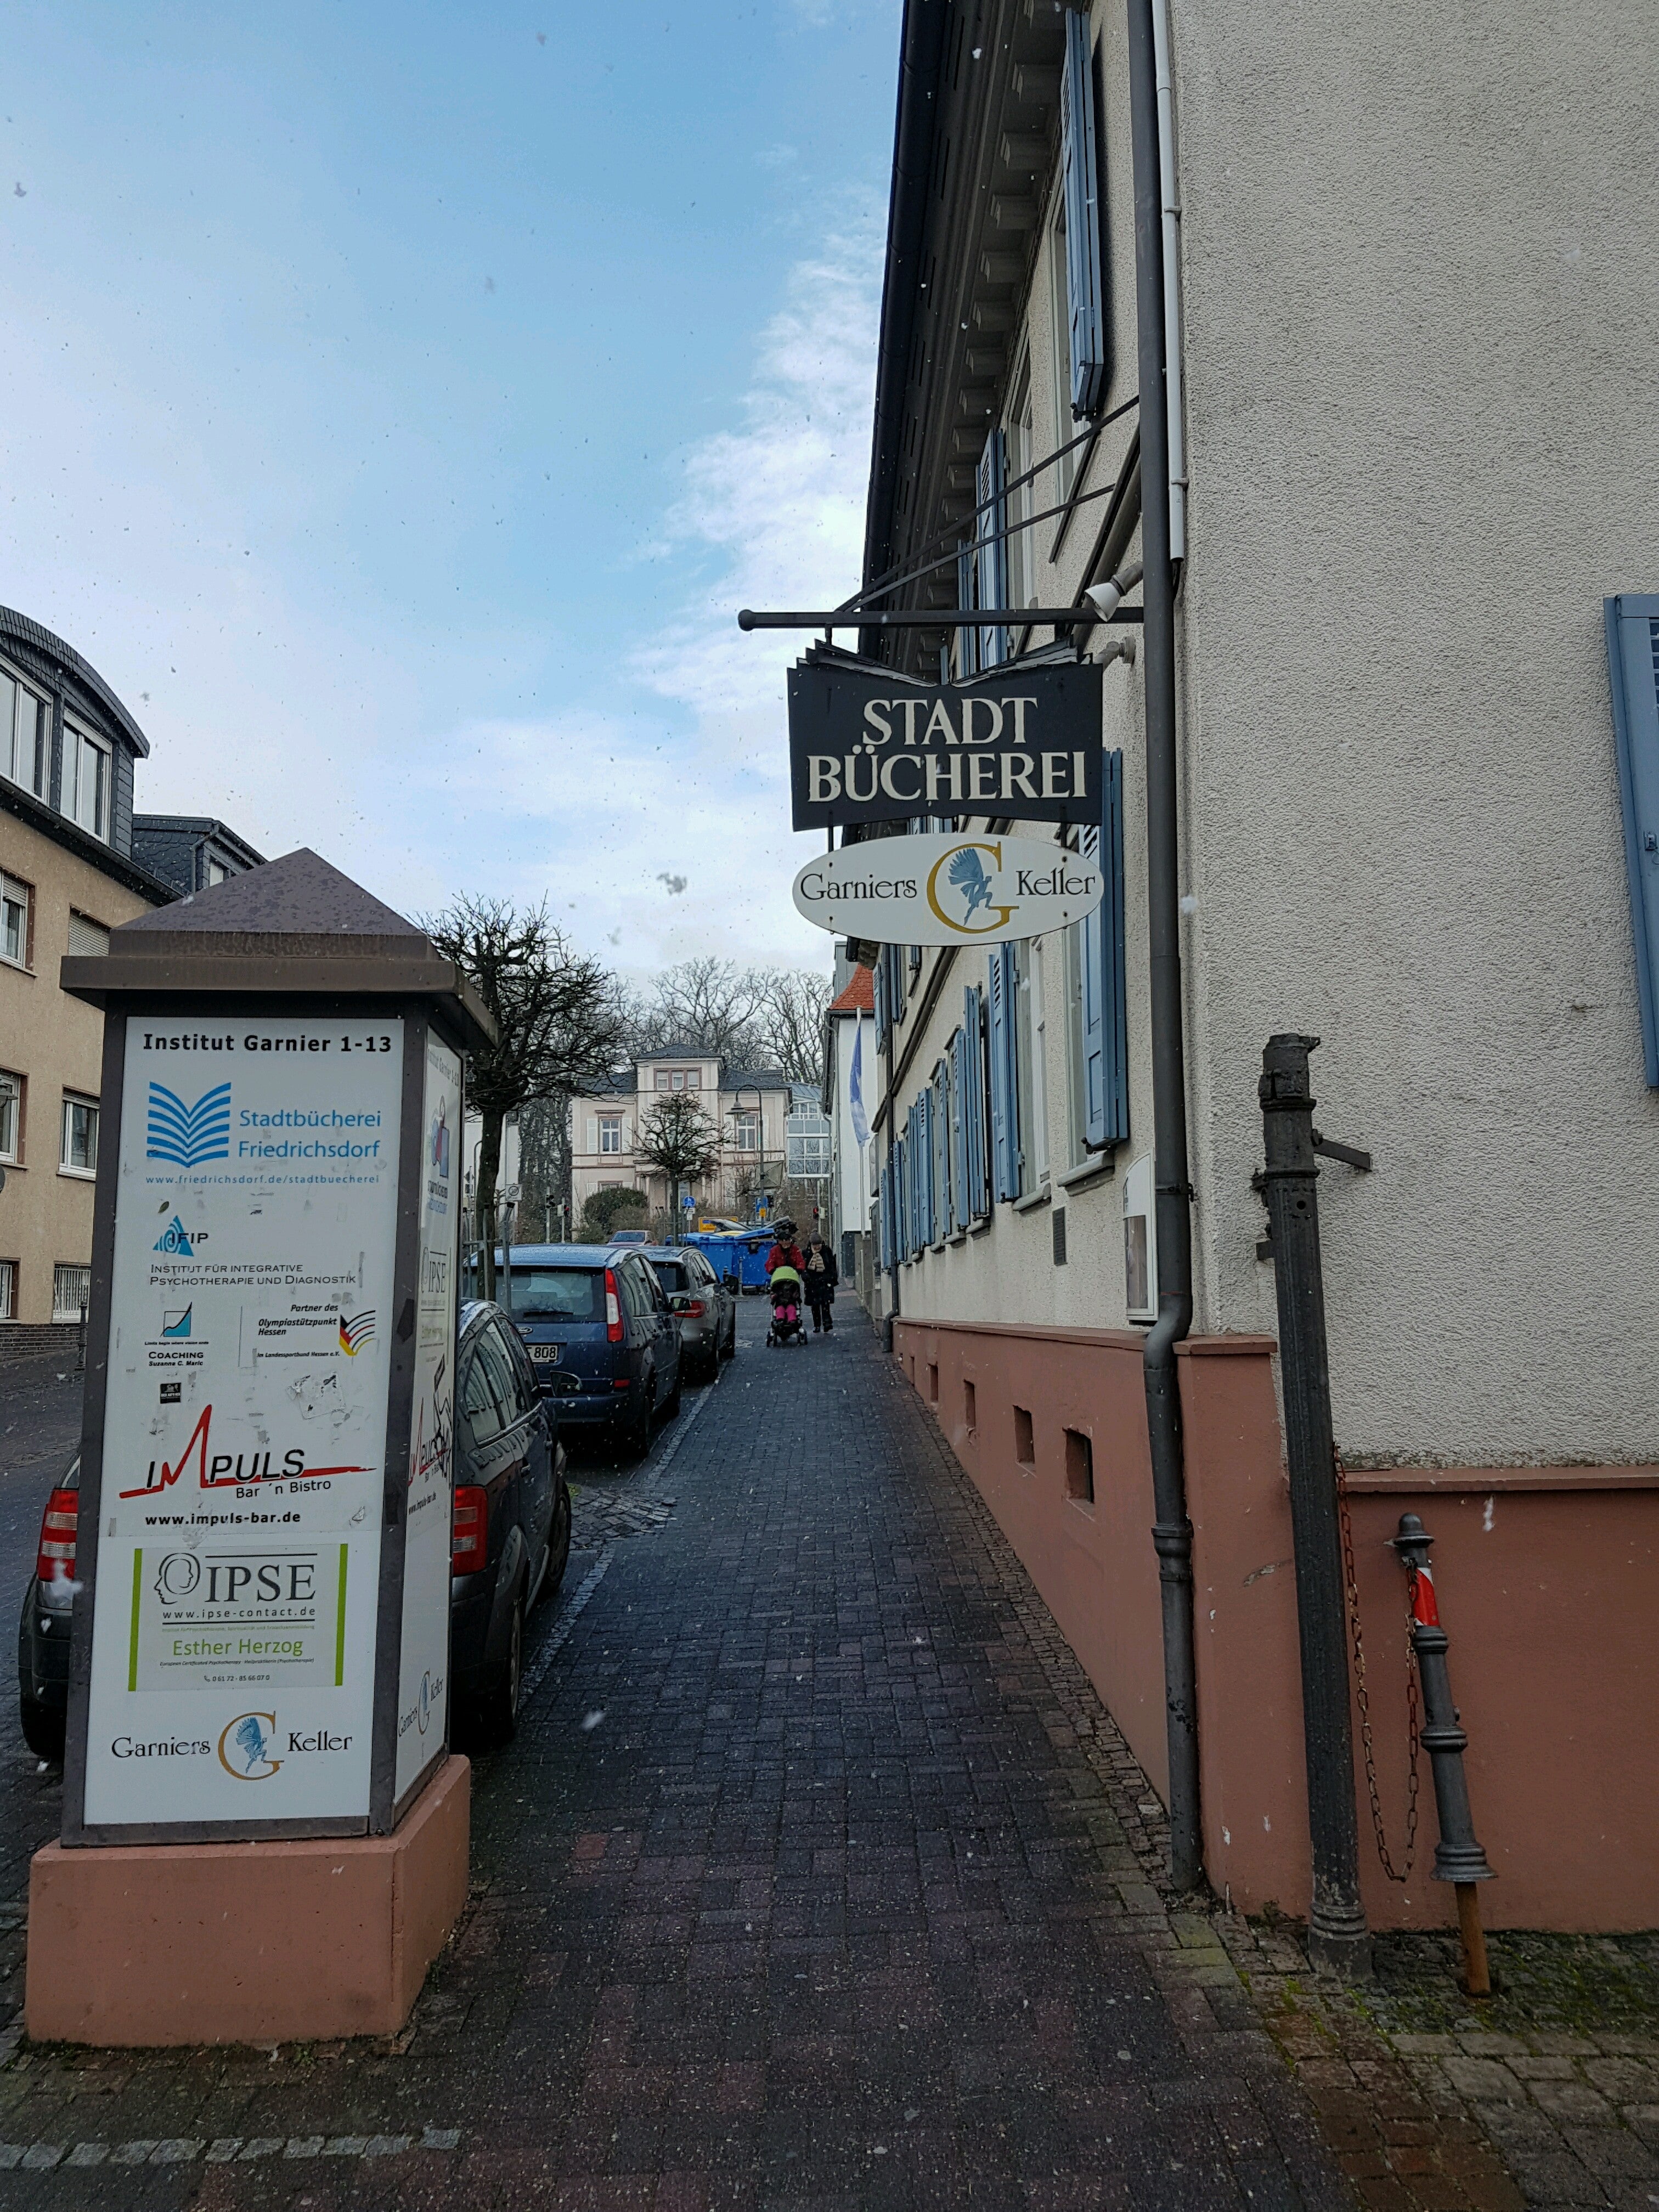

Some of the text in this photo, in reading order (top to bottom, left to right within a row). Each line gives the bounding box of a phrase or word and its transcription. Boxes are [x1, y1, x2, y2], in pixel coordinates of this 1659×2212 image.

[862, 697, 1038, 746] STADT
[806, 744, 1087, 803] BÜCHEREI
[800, 873, 918, 900] Garniers
[1016, 867, 1096, 897] Keller
[143, 1034, 392, 1052] Institut Garnier 1-13
[239, 1109, 381, 1127] Stadtbücherei
[239, 1140, 381, 1158] Friedrichsdorf
[145, 1174, 380, 1184] www.friedrichsdorf.de/stadtbuecherei
[171, 1233, 208, 1244] IFIP
[151, 1263, 303, 1273] INSTITUT FÜR INTEGRATIVE
[428, 1261, 445, 1293] IPSE
[150, 1276, 357, 1285] PSYCHOTHERAPIE UND DIAGNOSTIK
[258, 1318, 337, 1327] Olympiastützpunkt
[534, 1347, 556, 1358] 808
[146, 1404, 306, 1489] IMPULS
[236, 1487, 260, 1499] Bar
[290, 1480, 331, 1493] Bistro
[145, 1511, 301, 1527] www.impuls-bar.de
[205, 1564, 317, 1603] IPSE
[162, 1607, 315, 1620] www.ipse-contact.de
[173, 1638, 303, 1656] Esther Herzog
[111, 1736, 211, 1758] Garniers
[288, 1730, 353, 1752] Keller
